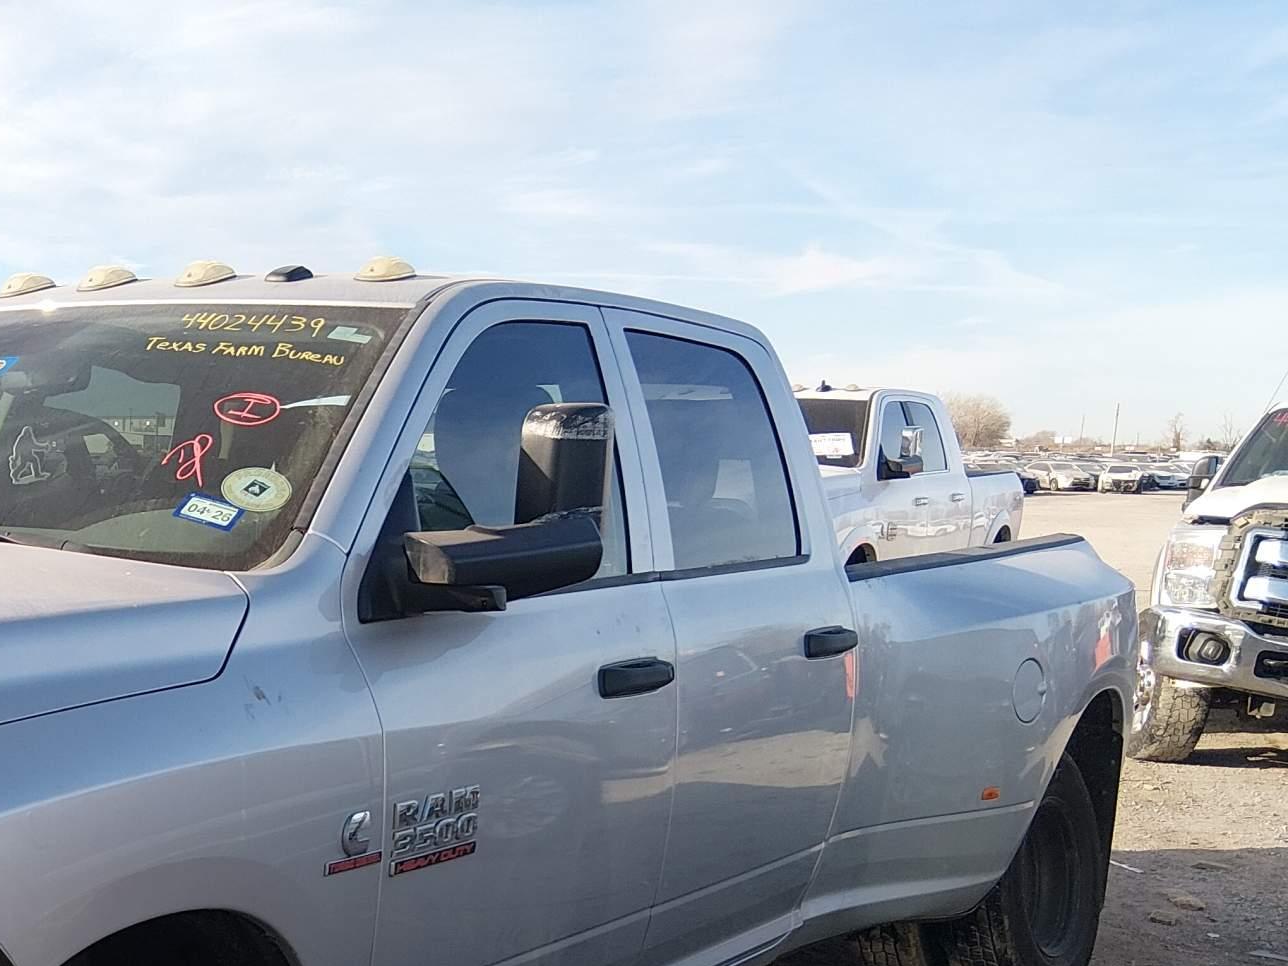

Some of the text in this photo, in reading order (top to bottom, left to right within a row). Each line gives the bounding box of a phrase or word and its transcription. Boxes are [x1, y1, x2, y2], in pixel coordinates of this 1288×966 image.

[182, 312, 325, 338] 44024439
[212, 342, 265, 357] FARM
[211, 510, 233, 522] 26
[392, 784, 480, 830] RAM
[391, 812, 478, 857] 3500
